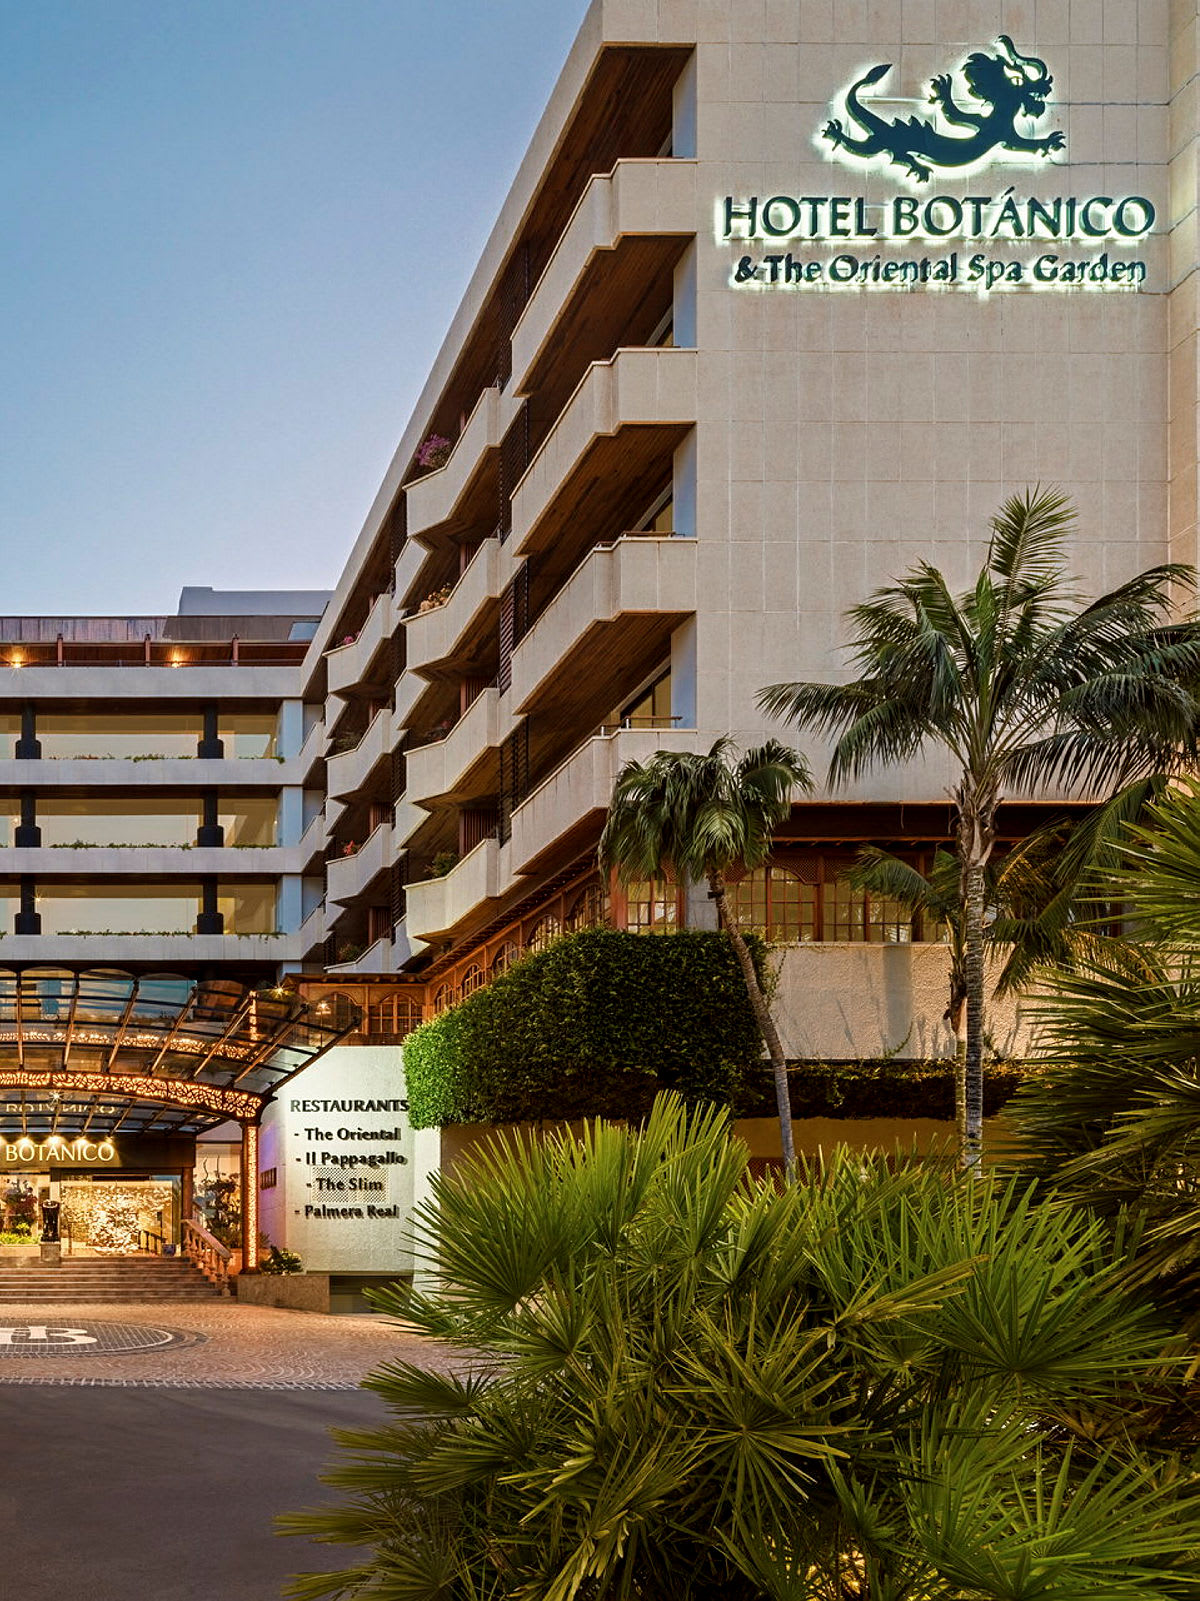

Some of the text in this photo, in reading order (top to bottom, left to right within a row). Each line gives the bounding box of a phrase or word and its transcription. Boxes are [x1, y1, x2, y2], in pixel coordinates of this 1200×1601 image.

[722, 186, 1156, 236] HOTEL BOTÁNICO
[764, 253, 822, 283] The
[829, 252, 957, 283] Oriental
[967, 253, 1023, 290] Spa
[1033, 253, 1146, 283] Garden
[290, 1099, 409, 1113] RESTAURANTS
[304, 1127, 333, 1141] The
[337, 1127, 401, 1141] Oriental
[321, 1151, 408, 1169] Pappagallo
[316, 1177, 345, 1191] The
[349, 1177, 383, 1191] Slim
[304, 1204, 364, 1219] Palmera
[367, 1204, 399, 1219] Real
